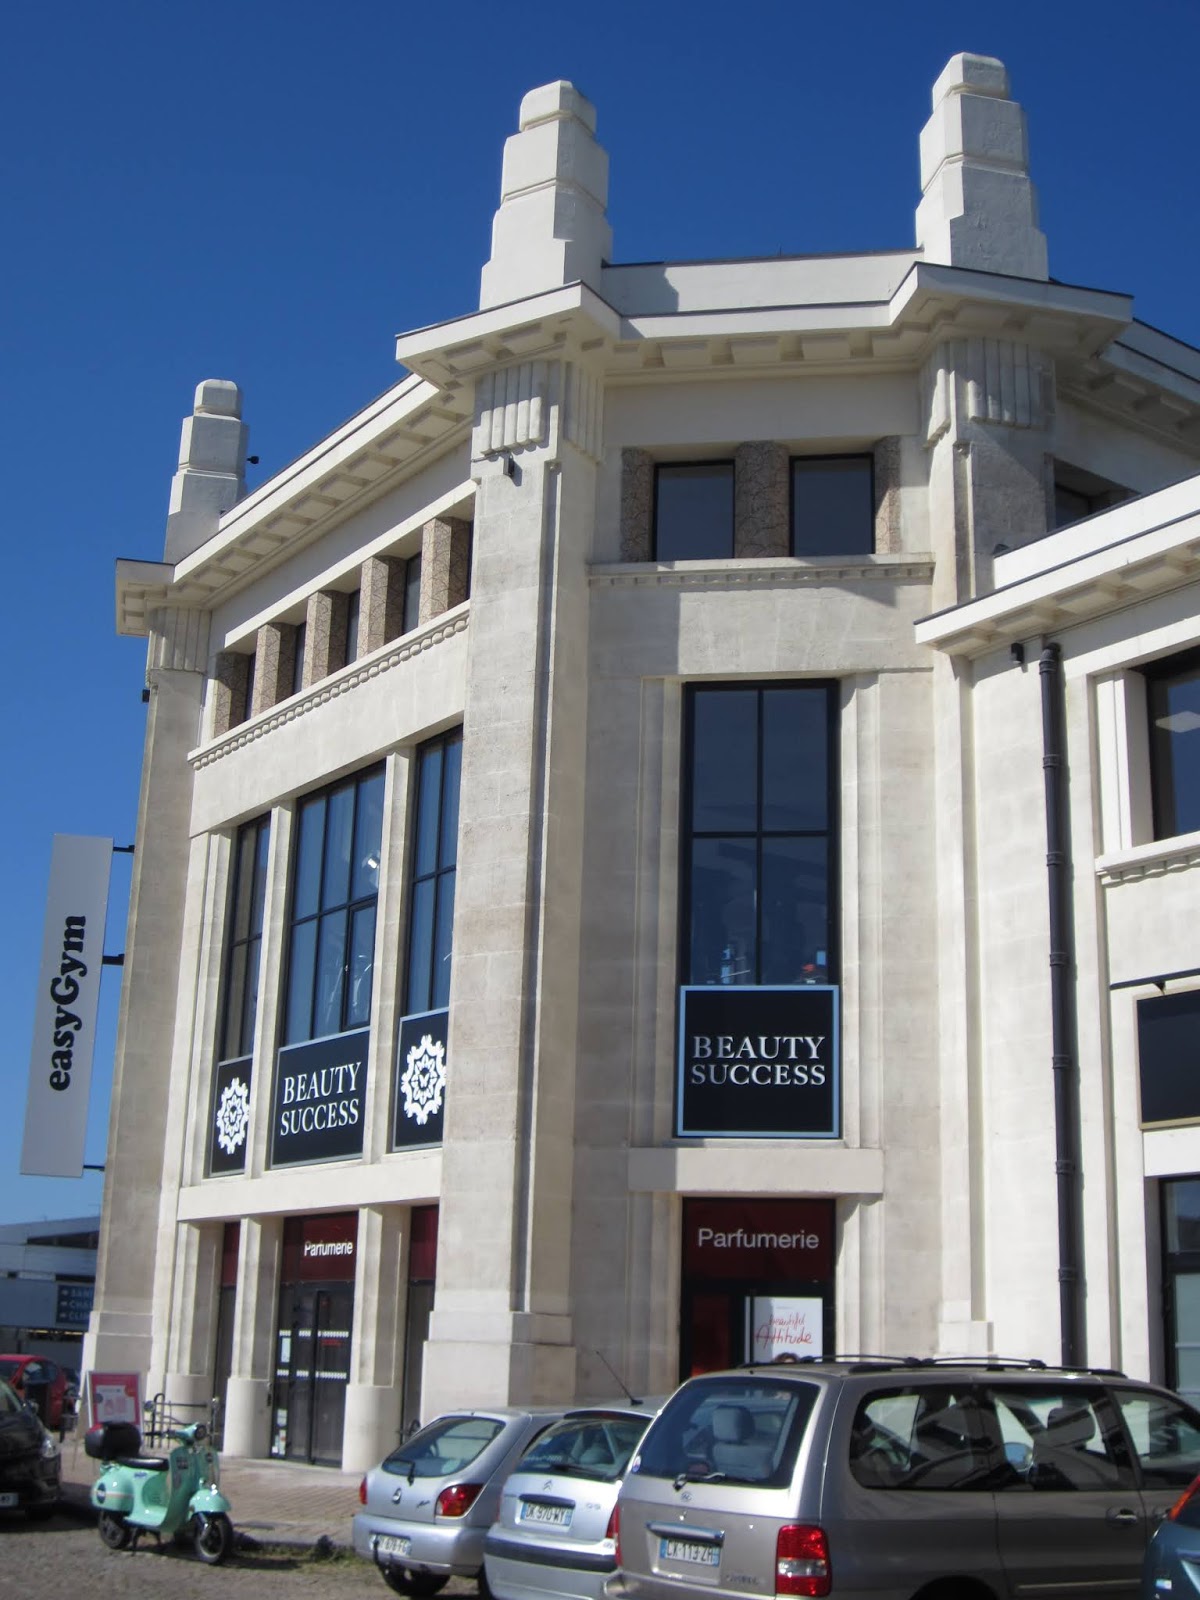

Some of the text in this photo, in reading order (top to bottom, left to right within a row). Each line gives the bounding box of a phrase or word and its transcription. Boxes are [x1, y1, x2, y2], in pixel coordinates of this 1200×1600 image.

[50, 915, 88, 1091] easyGym
[692, 1035, 826, 1059] BEAUTY
[282, 1061, 362, 1105] BEAUTY
[691, 1063, 826, 1086] SUCCESS
[280, 1098, 359, 1137] SUCCESS
[303, 1239, 354, 1257] Parfumerie
[698, 1227, 820, 1249] Parfumerie
[754, 1323, 813, 1349] Attitude
